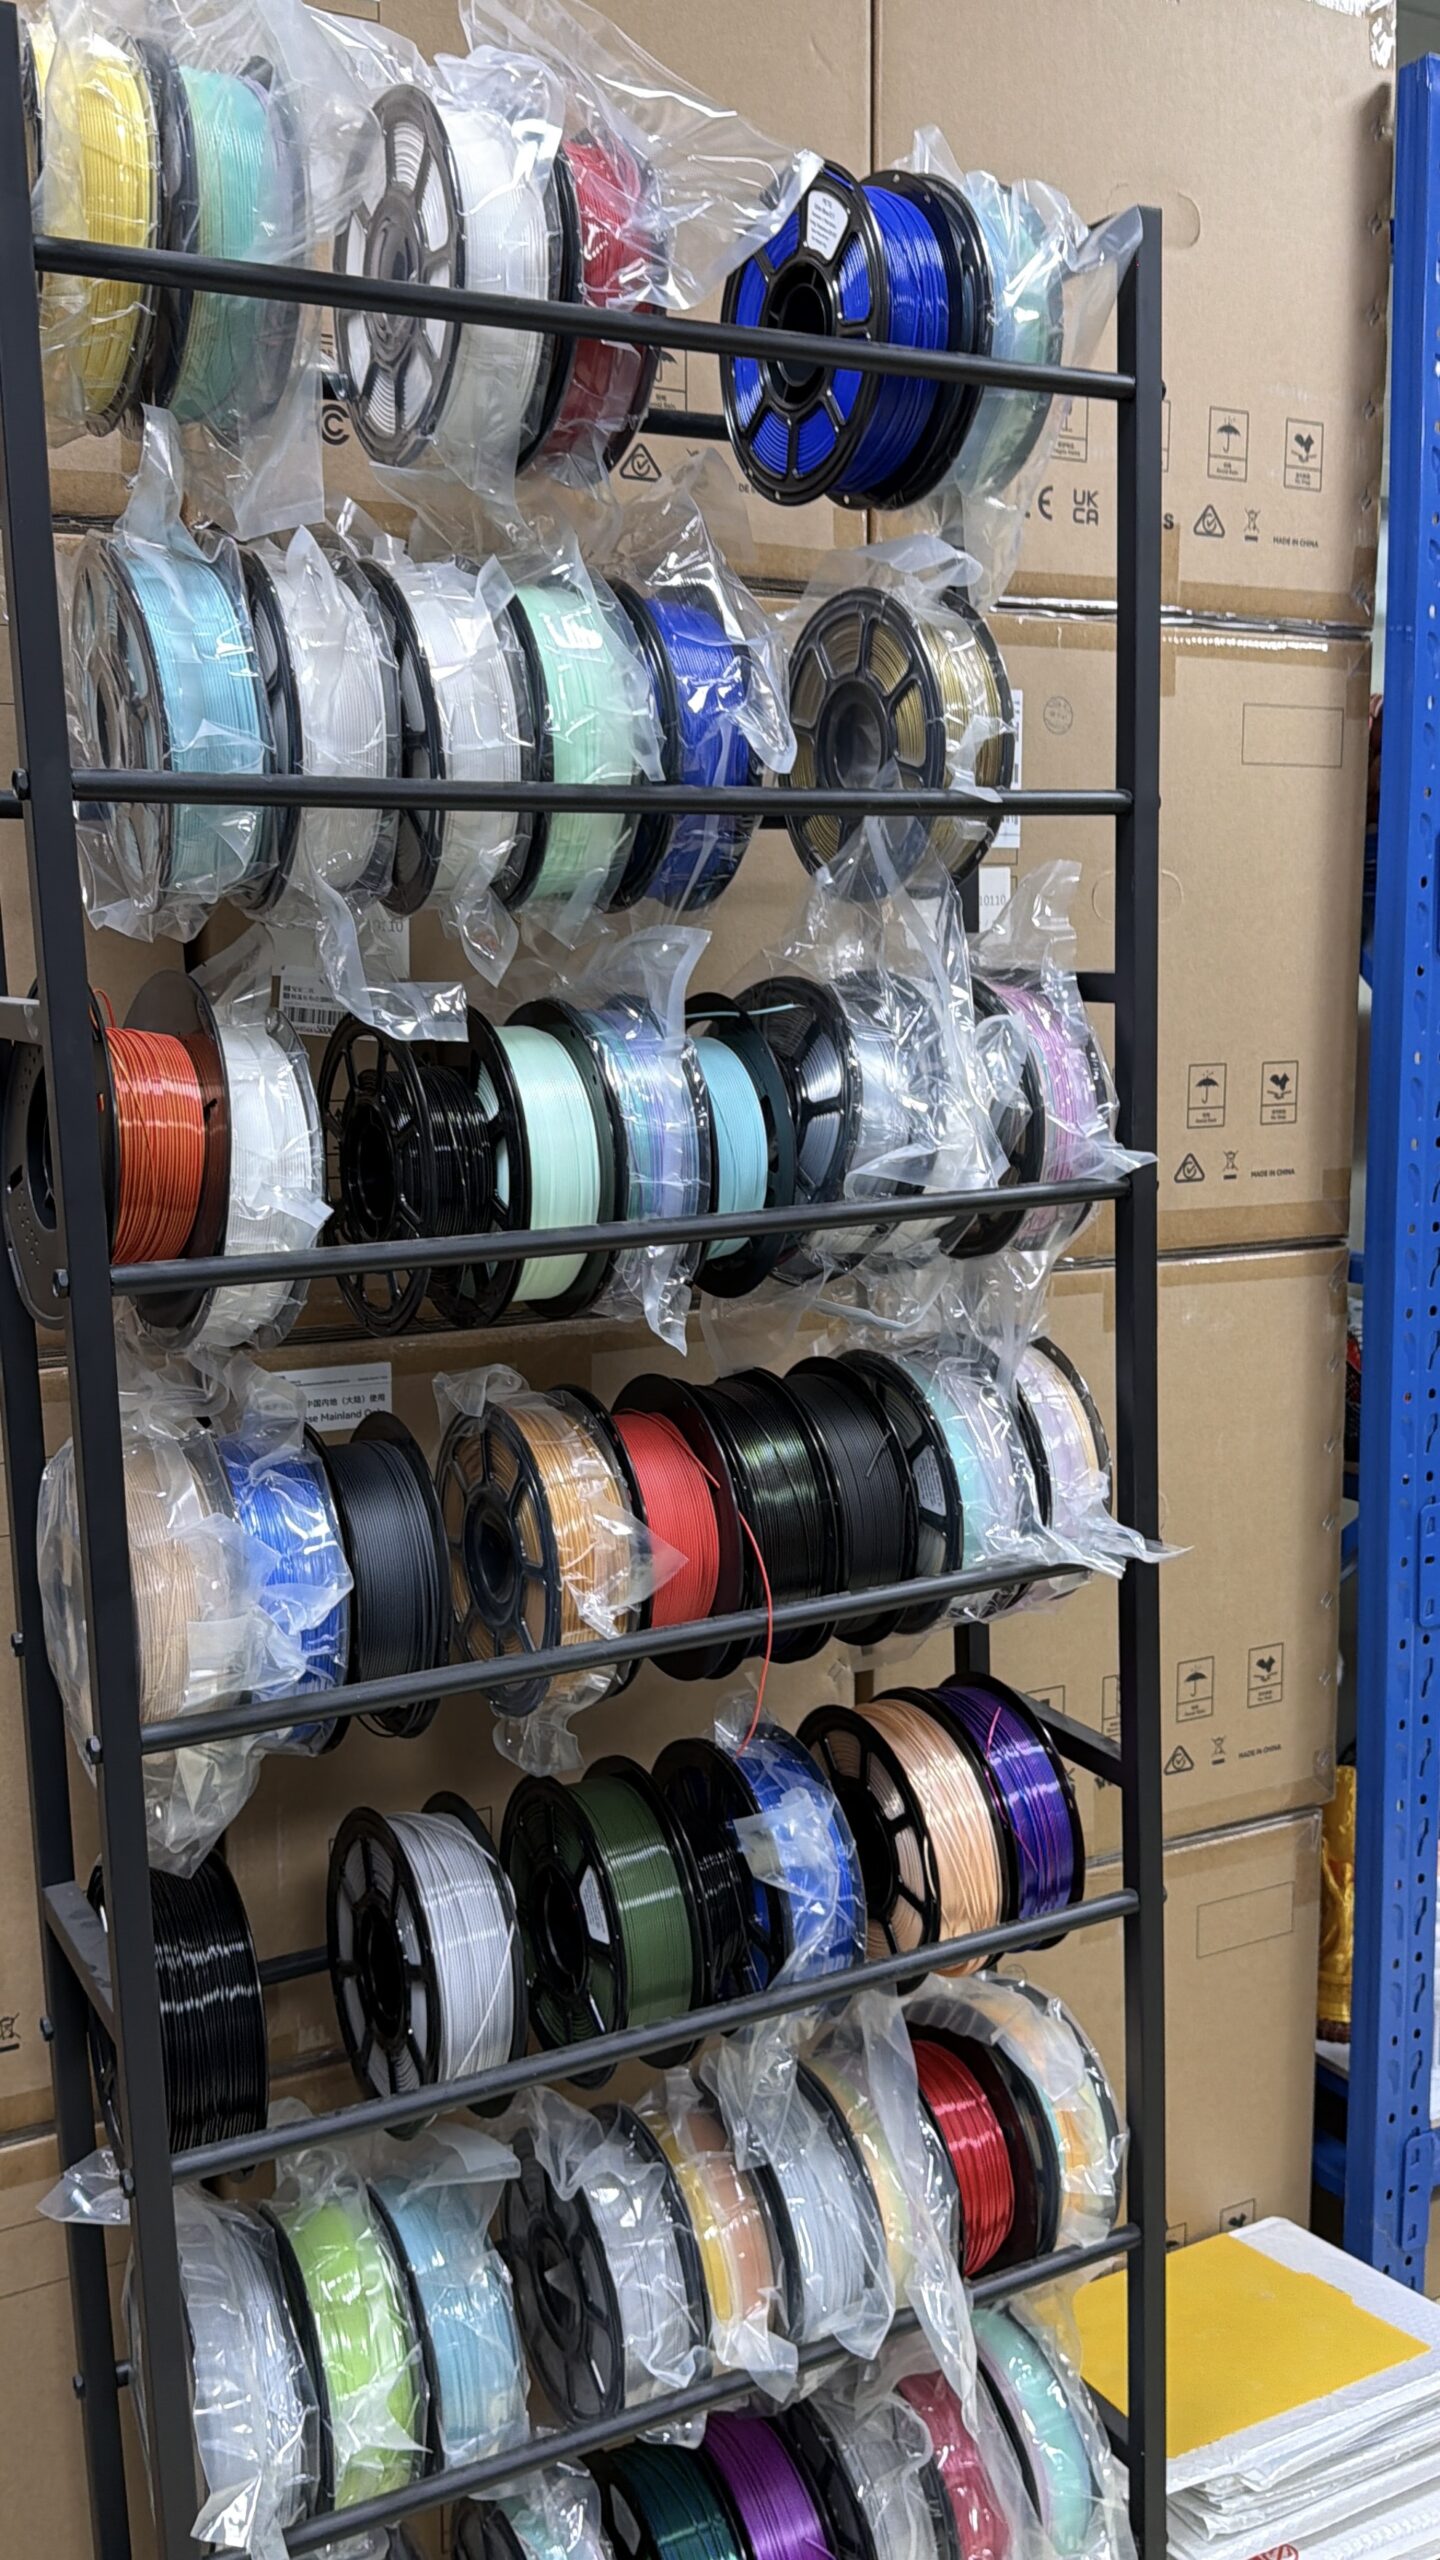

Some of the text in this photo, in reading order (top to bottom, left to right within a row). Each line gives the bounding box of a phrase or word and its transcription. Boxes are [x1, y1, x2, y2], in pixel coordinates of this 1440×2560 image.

[1072, 488, 1099, 509] UK
[1072, 507, 1099, 526] CA
[1273, 536, 1291, 547] MADE
[1300, 538, 1319, 549] CHINA
[1250, 1170, 1268, 1178] MADE
[1276, 1167, 1295, 1177] CHINA
[320, 1409, 362, 1422] Mainland
[1238, 1750, 1256, 1760] MADE
[1263, 1744, 1281, 1754] CHINA
